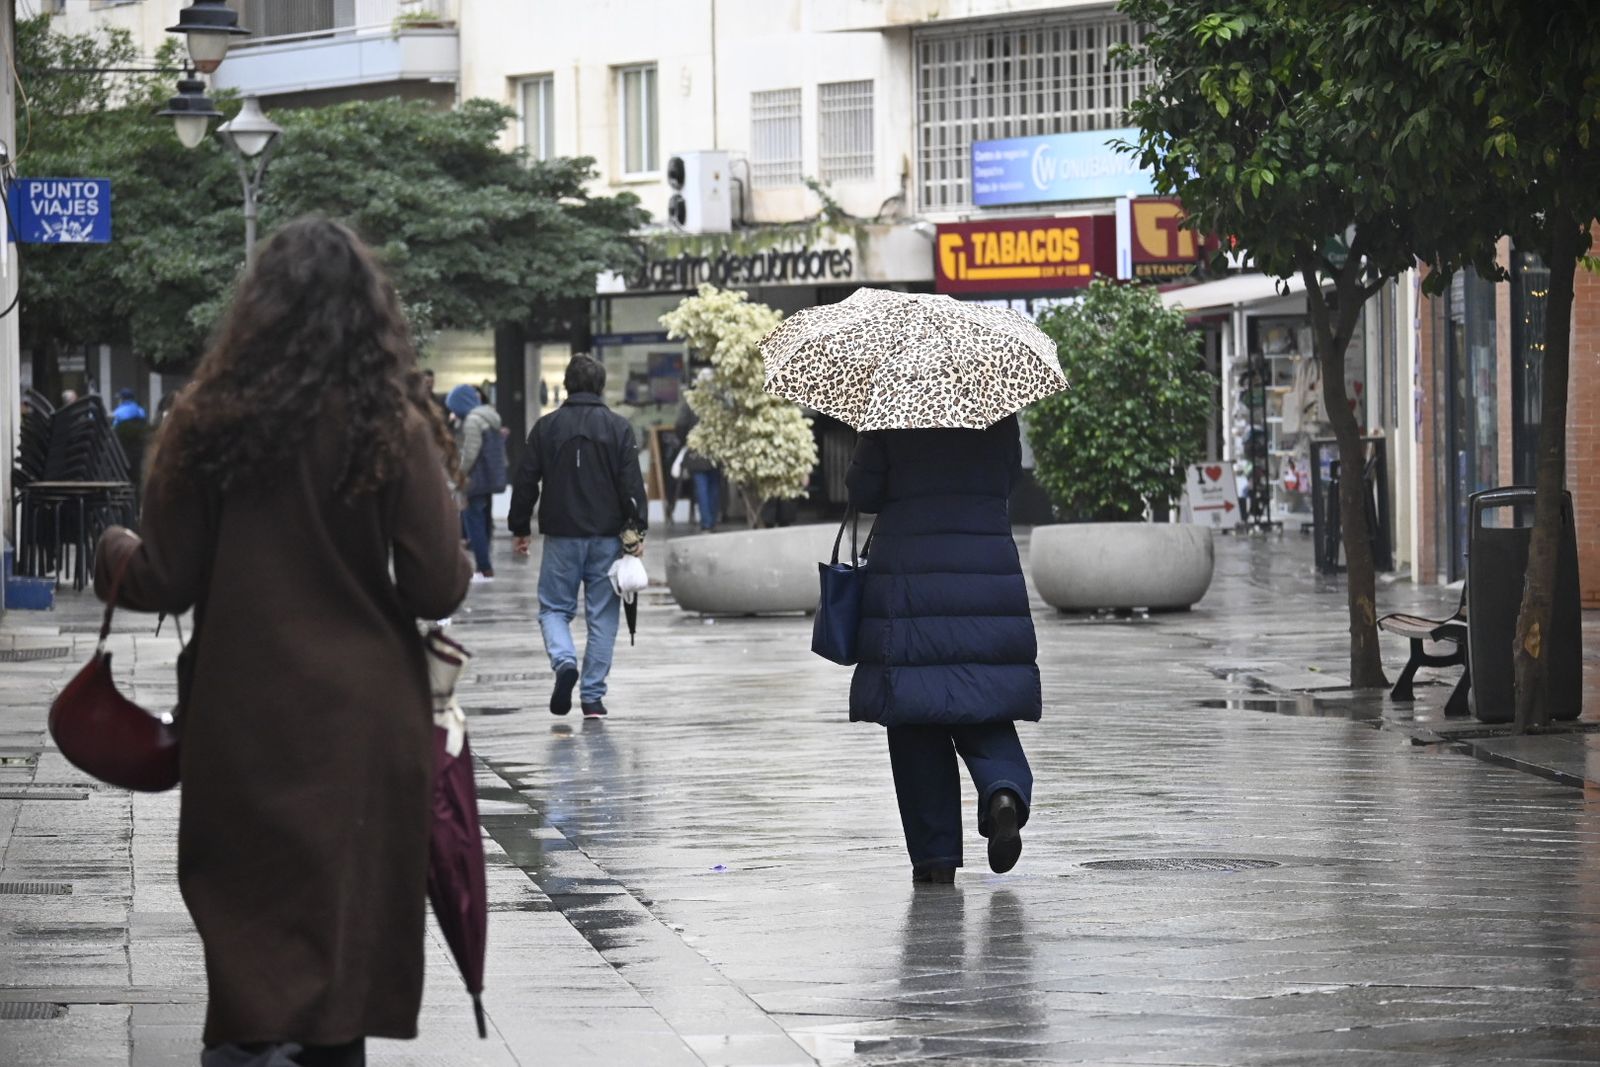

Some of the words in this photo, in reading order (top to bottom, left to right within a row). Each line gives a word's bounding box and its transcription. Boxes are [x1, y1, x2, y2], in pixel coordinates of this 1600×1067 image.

[30, 182, 99, 199] PUNTO
[31, 199, 99, 216] VIAJES
[971, 227, 1080, 265] TABACOS
[1195, 466, 1206, 485] I
